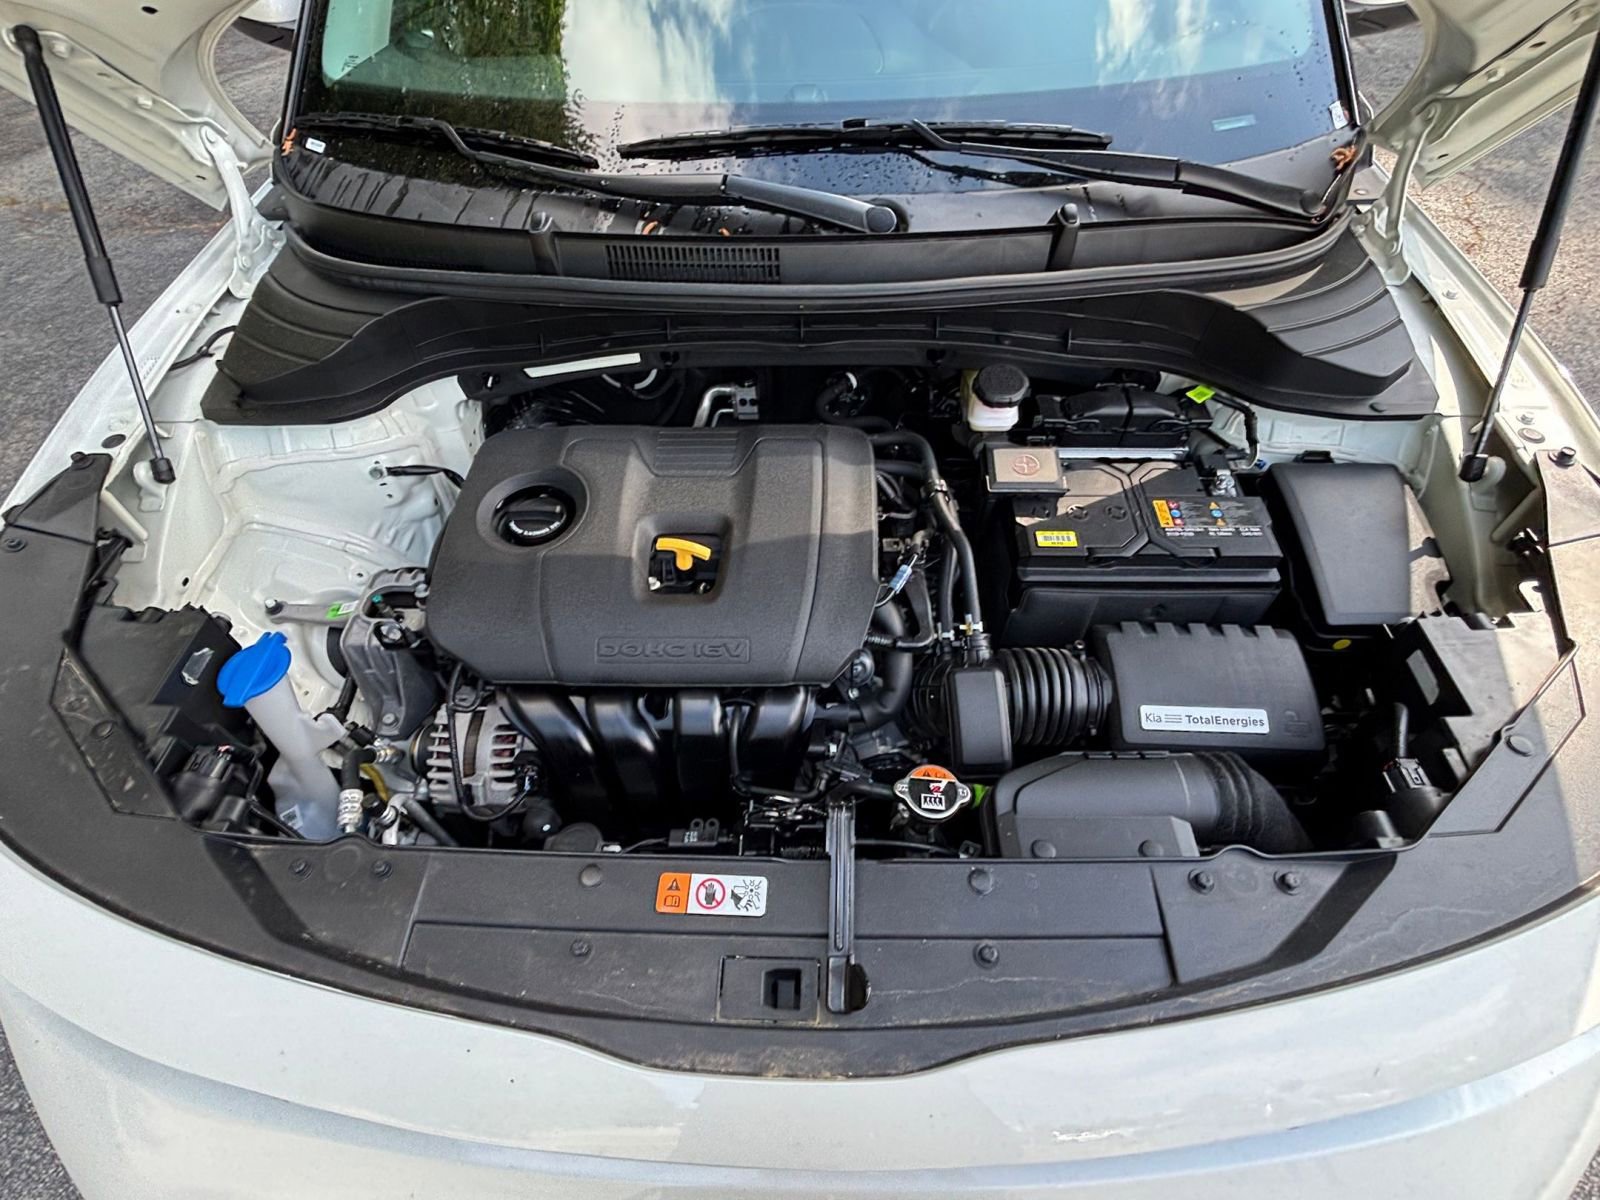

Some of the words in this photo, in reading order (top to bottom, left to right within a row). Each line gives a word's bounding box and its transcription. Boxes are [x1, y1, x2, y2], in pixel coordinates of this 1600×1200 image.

[597, 642, 686, 658] DOHC
[693, 642, 743, 658] 16V
[1144, 712, 1163, 724] Kia
[1185, 714, 1265, 728] TotalEnergies
